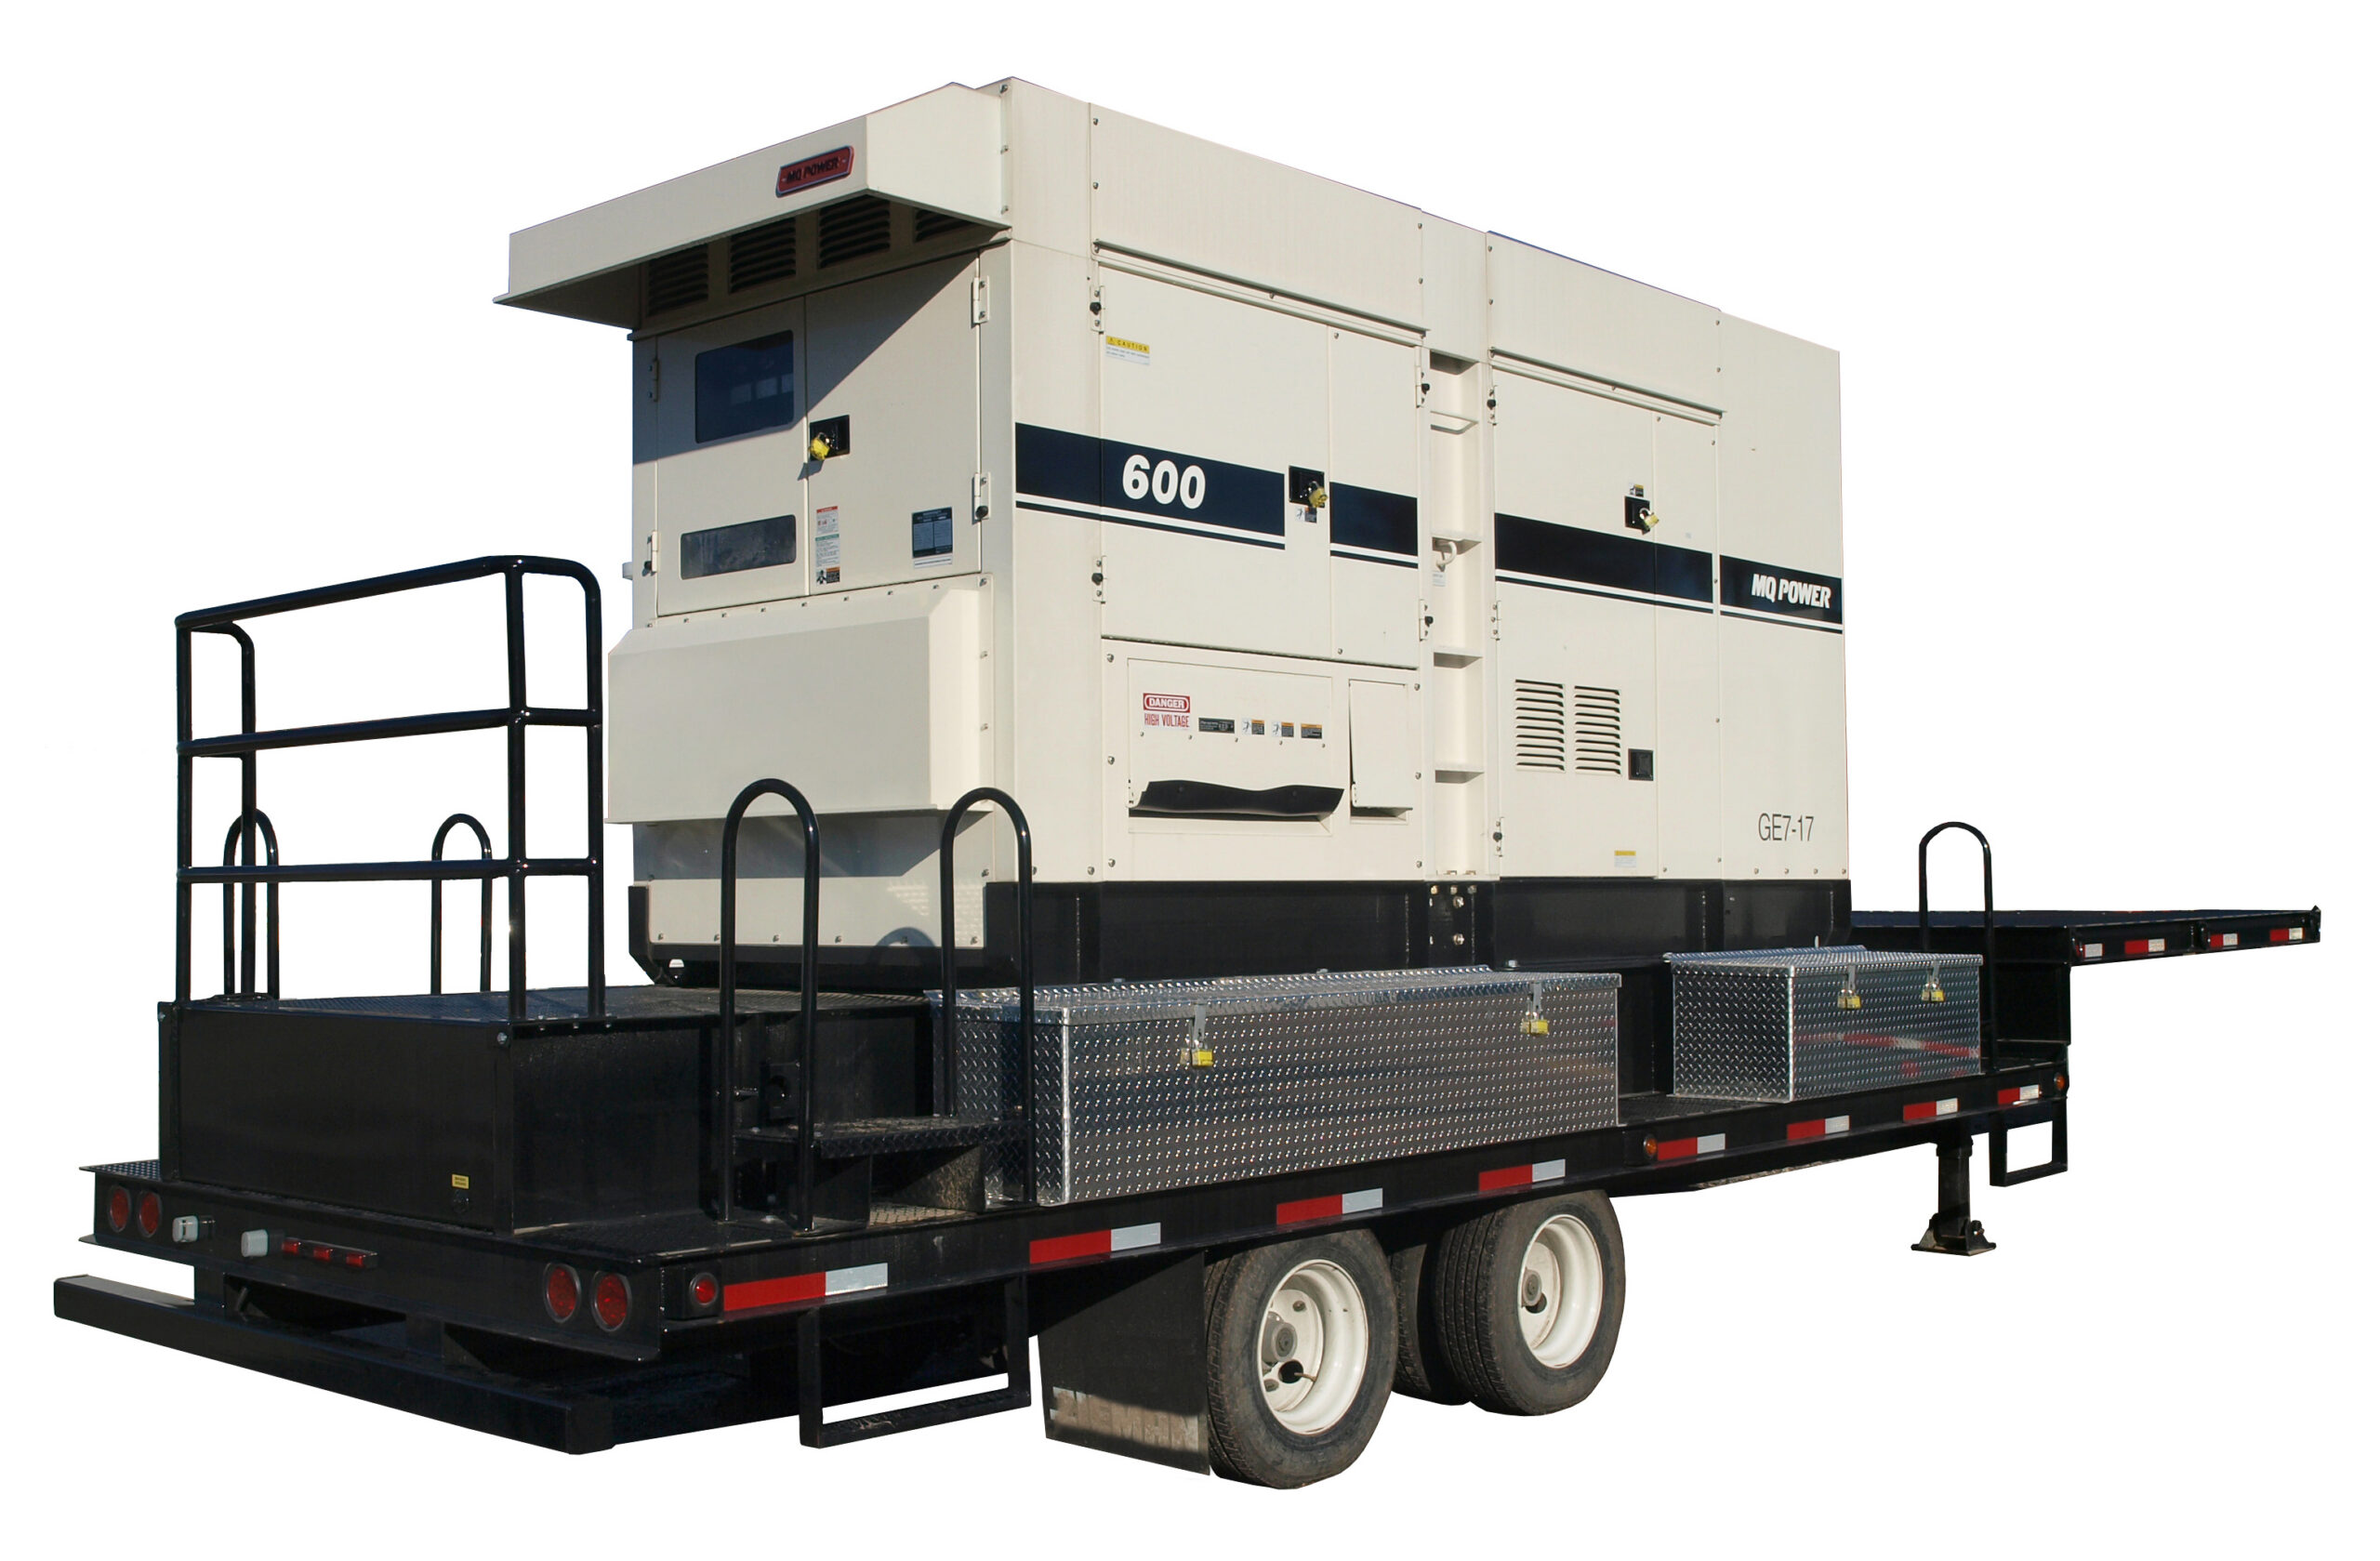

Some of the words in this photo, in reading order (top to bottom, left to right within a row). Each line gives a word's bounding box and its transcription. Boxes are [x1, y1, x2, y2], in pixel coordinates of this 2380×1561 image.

[1117, 338, 1149, 352] CAUTION
[1122, 454, 1206, 509] 600
[1751, 573, 1777, 602] MQ
[1778, 578, 1831, 609] POWER
[1148, 697, 1185, 709] DANGER
[1144, 713, 1159, 725] HIGH
[1161, 714, 1190, 727] VOLTAGE
[1758, 813, 1814, 841] GE7-17
